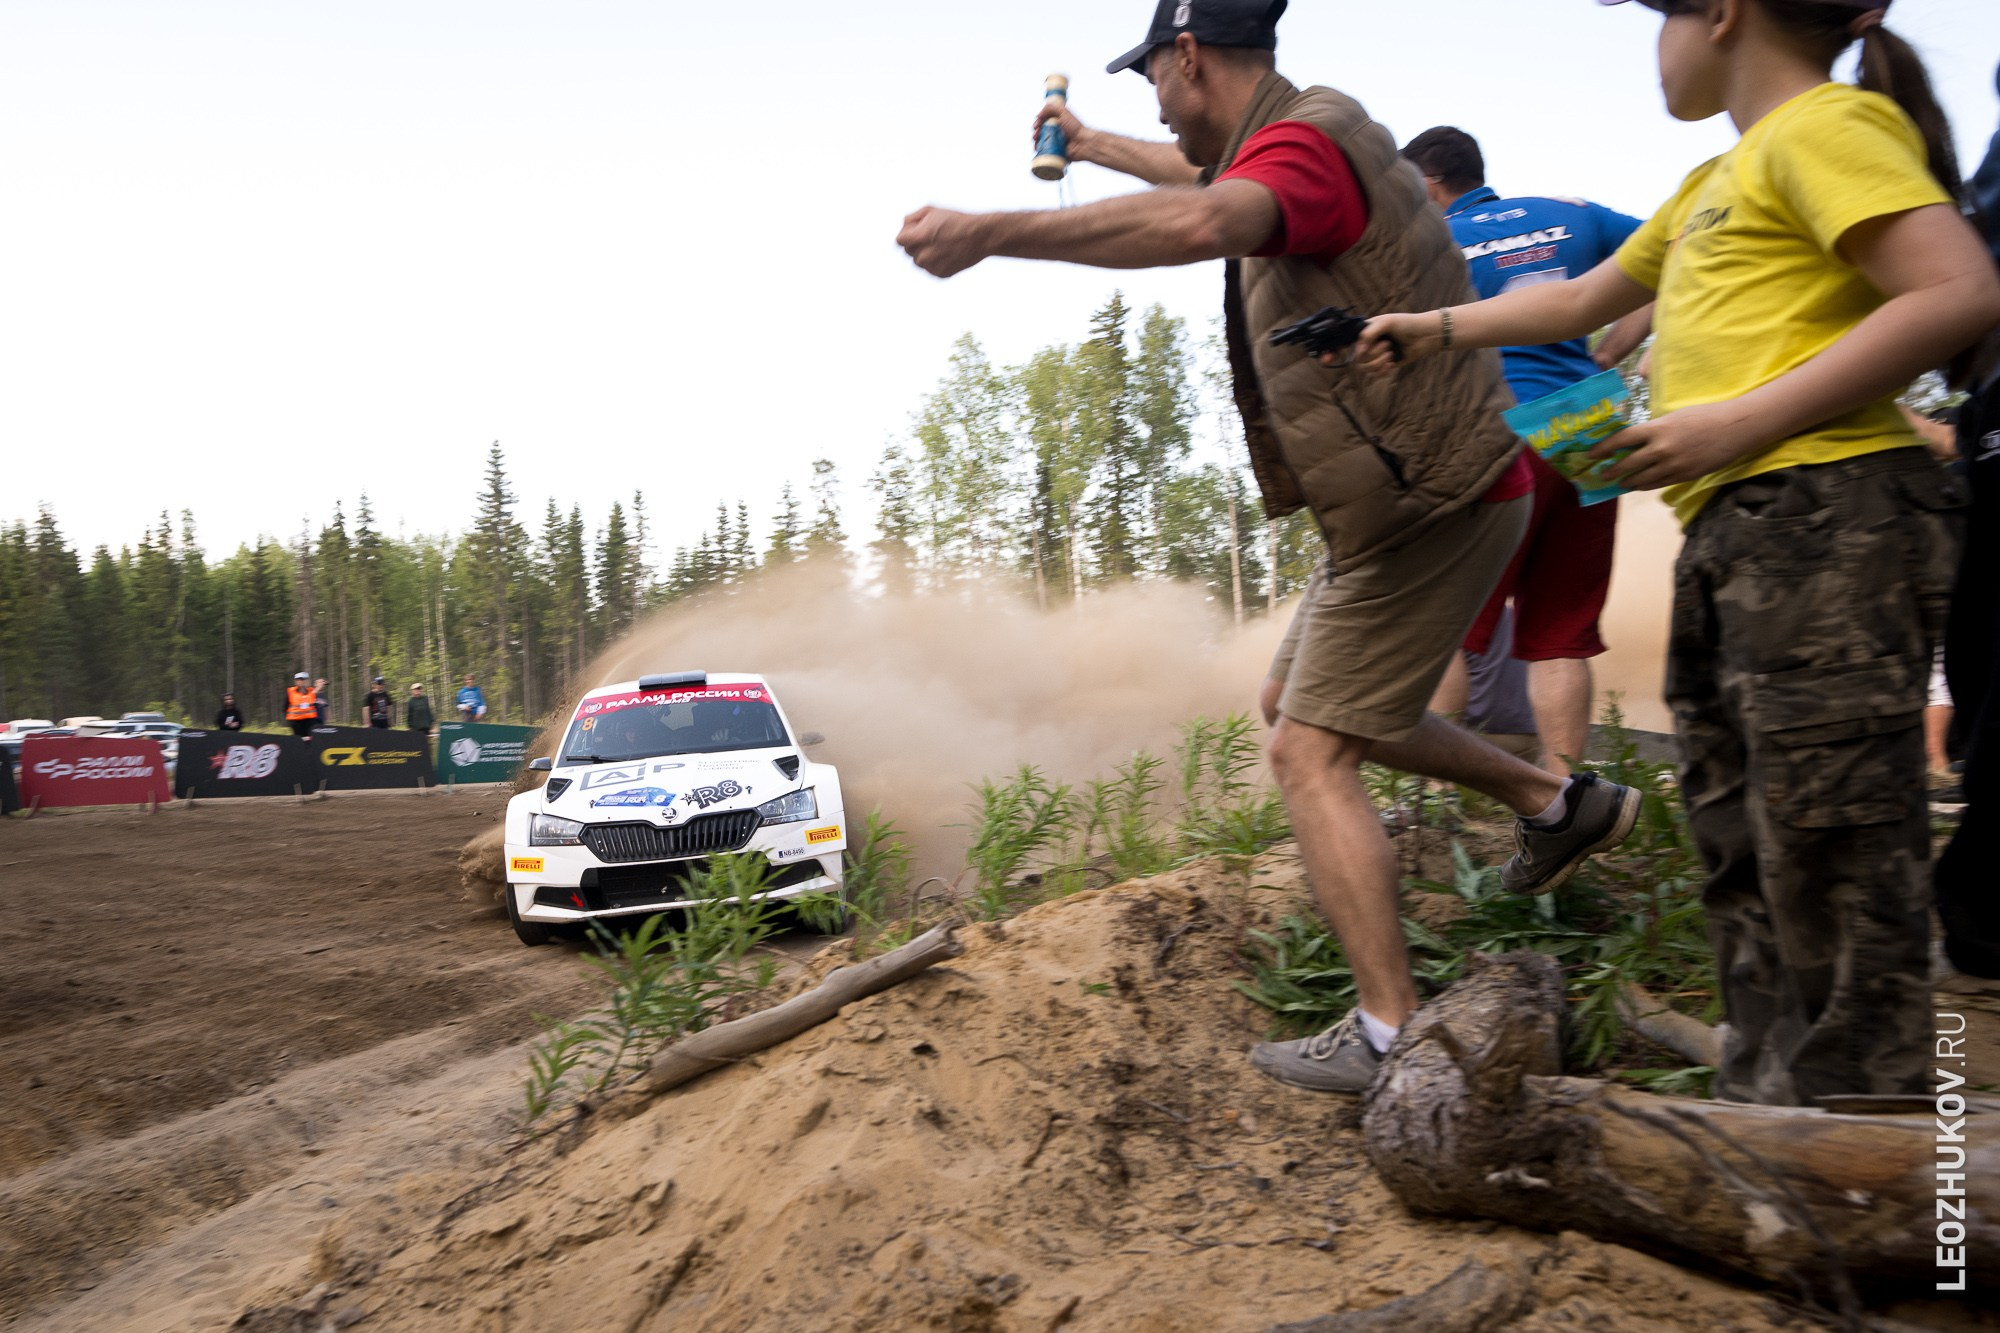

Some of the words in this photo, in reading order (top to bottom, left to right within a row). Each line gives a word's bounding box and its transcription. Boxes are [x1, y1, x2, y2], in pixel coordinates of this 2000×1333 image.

[1461, 225, 1573, 260] KAMAZ
[606, 694, 666, 709] РАЛЛИ
[672, 690, 740, 701] РОССИИ
[582, 717, 594, 731] 8
[694, 780, 743, 809] R8
[809, 828, 839, 841] PIRELLI
[514, 859, 541, 870] PIRELLI
